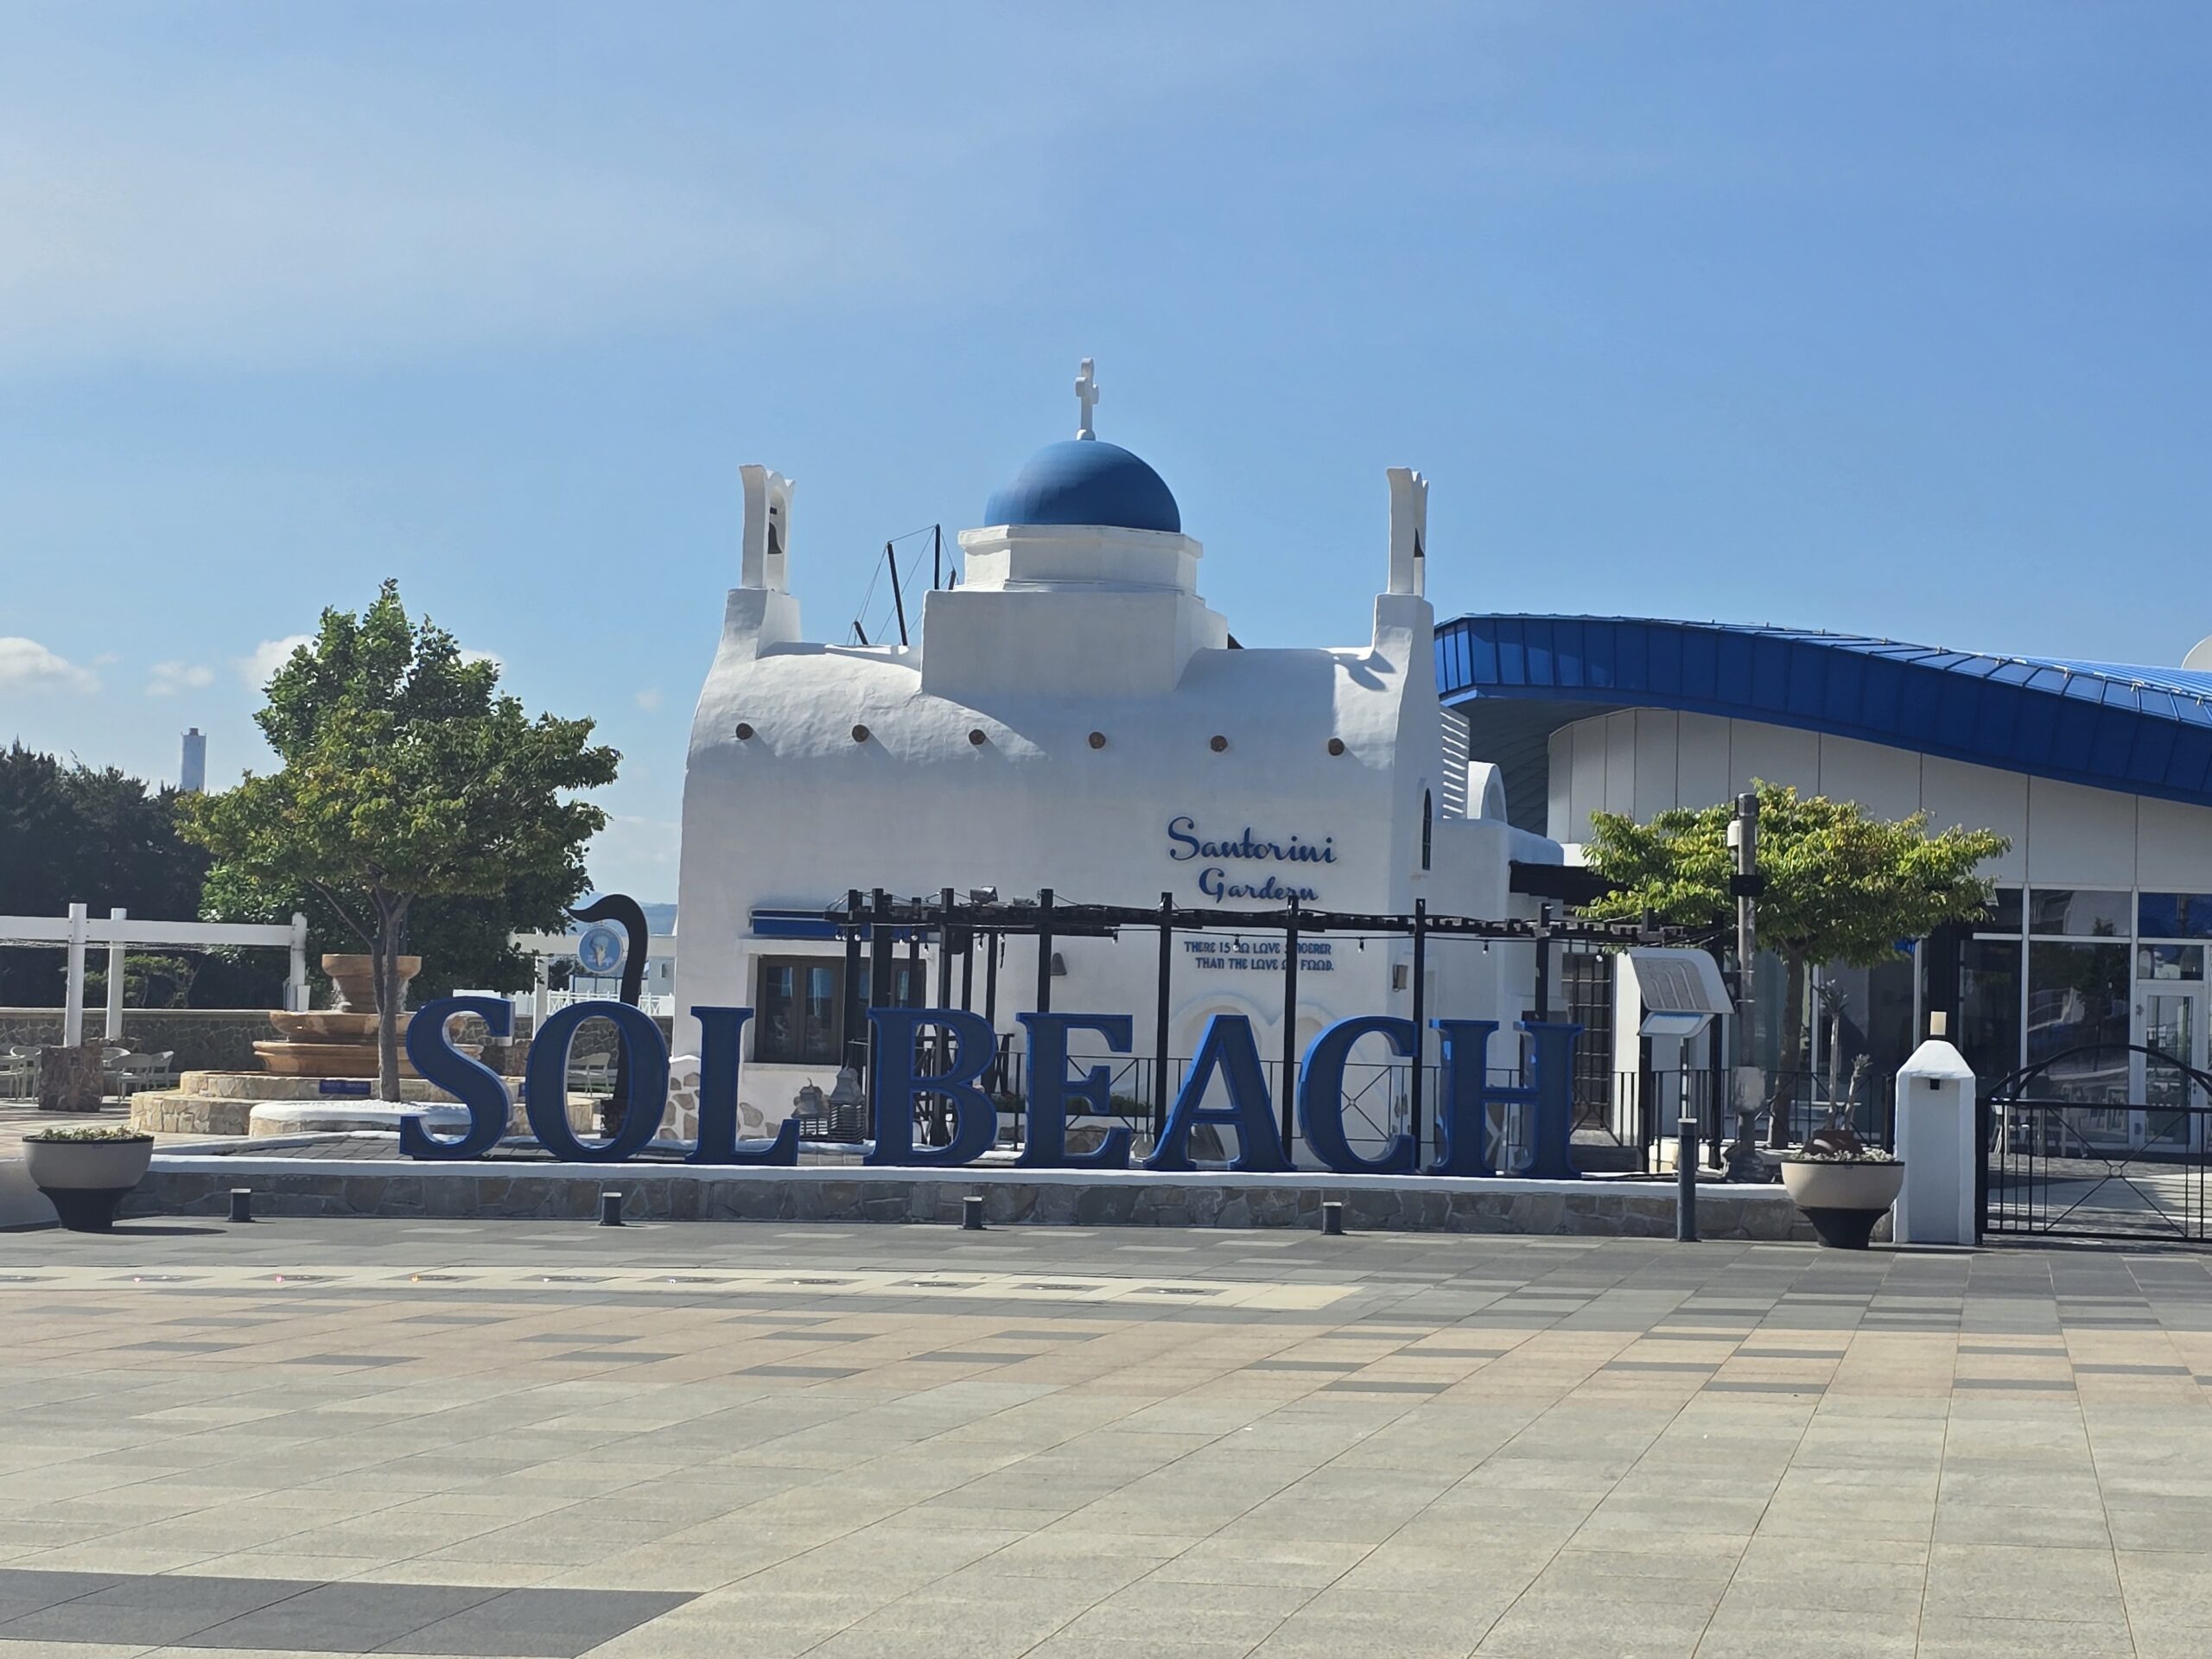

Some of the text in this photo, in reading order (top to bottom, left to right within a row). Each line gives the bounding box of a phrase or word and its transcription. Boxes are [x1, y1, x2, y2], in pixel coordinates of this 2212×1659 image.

[1167, 816, 1338, 863] Santorini
[1184, 941, 1217, 953] THERE
[1219, 942, 1231, 954] IS
[1253, 943, 1281, 954] LOVE
[1196, 957, 1224, 969] THAN
[1228, 957, 1249, 969] THE
[1251, 958, 1279, 970] LOVE
[1300, 959, 1335, 971] FOOD.
[399, 996, 1585, 1179] SOL BEACH
